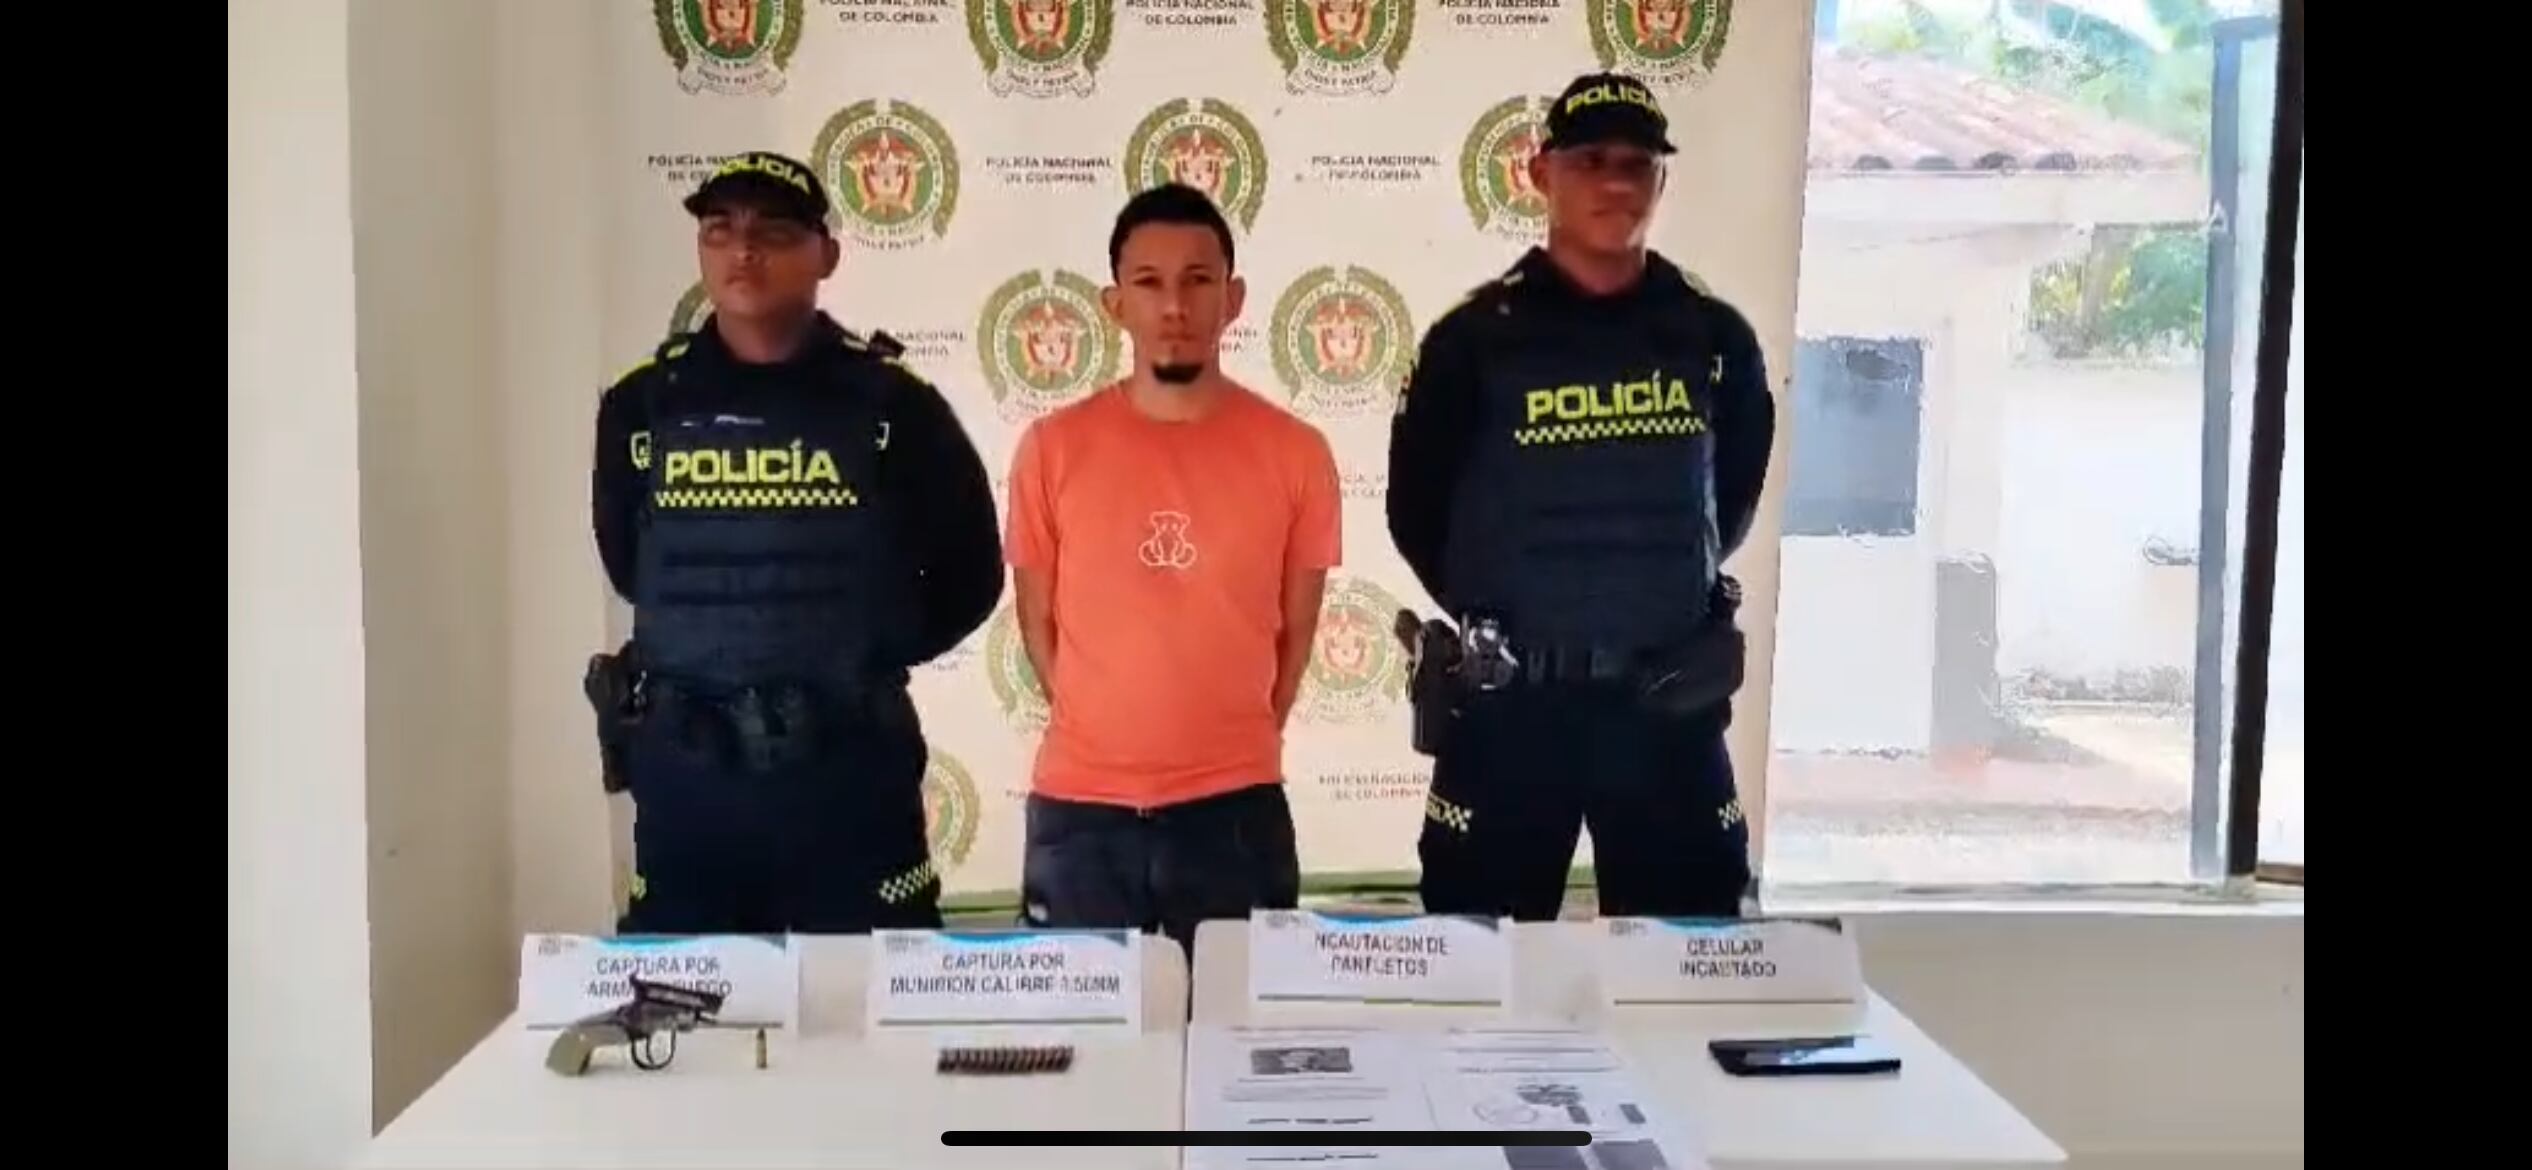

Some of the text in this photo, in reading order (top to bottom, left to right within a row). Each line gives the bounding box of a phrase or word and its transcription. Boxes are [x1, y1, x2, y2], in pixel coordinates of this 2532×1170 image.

[1145, 14, 1238, 25] DE COLOMBIA
[1456, 14, 1472, 25] DE
[1525, 370, 1691, 424] POLICÍA
[664, 437, 841, 484] POLICÍA
[1426, 936, 1449, 956] DE
[1686, 938, 1764, 956] CELULAR
[596, 956, 721, 976] CAPTURA POR
[942, 953, 1066, 971] CAPTURA POR
[1331, 955, 1429, 977] PANFLETOS
